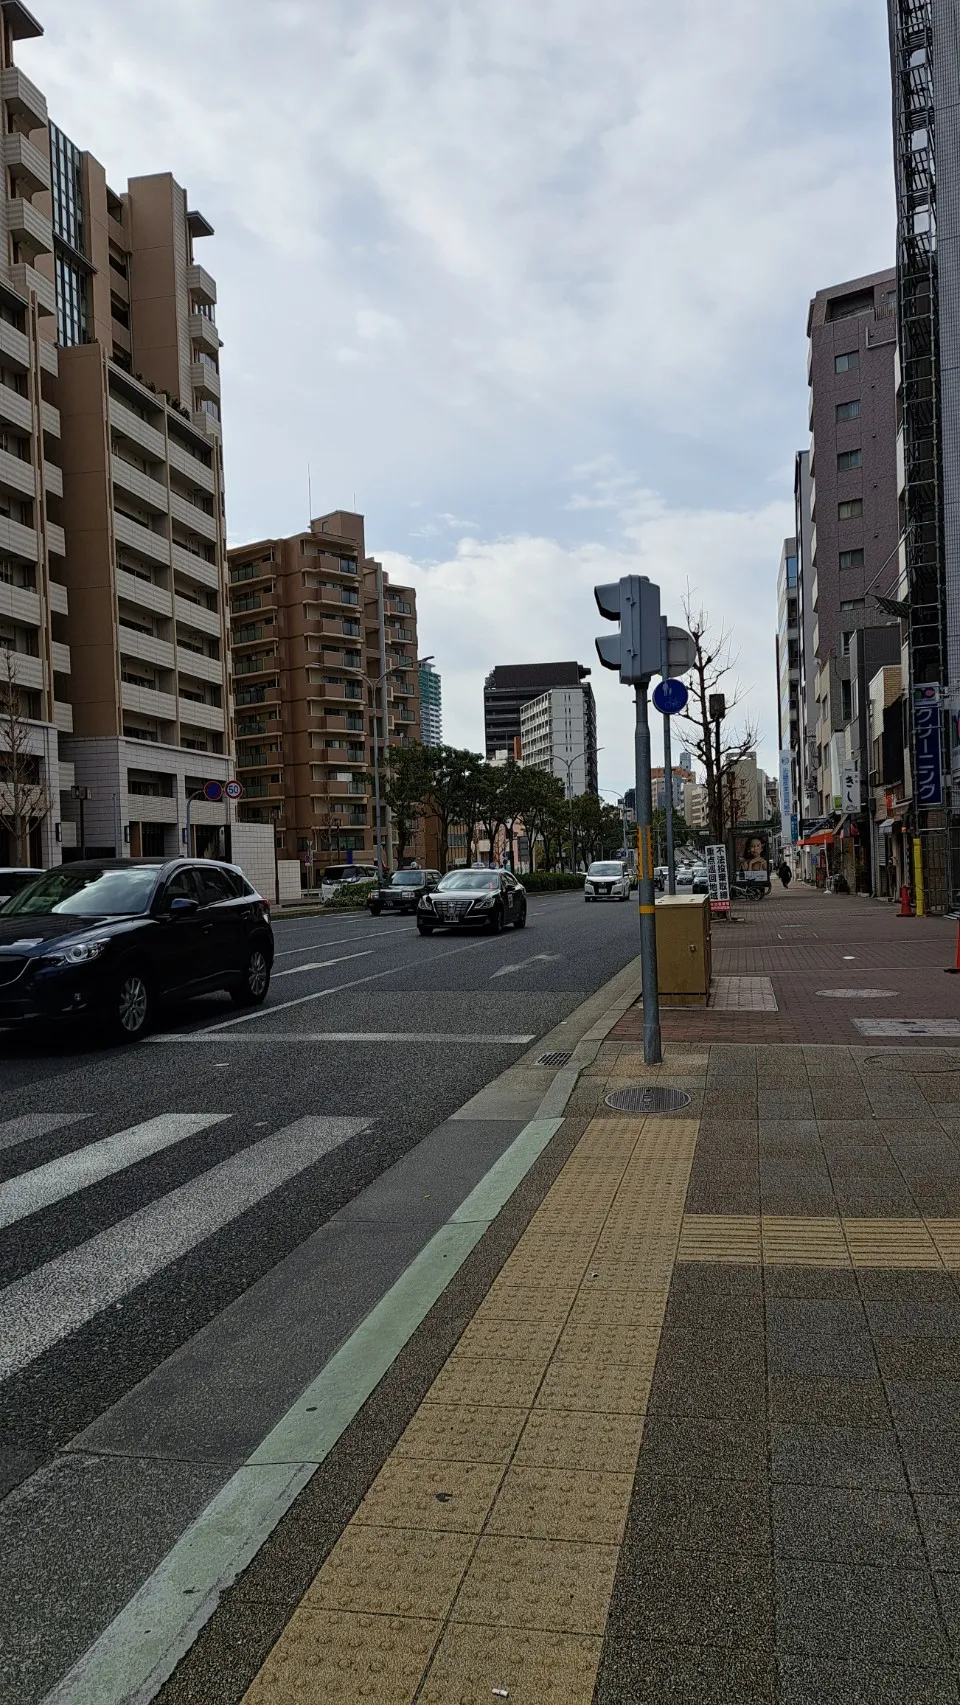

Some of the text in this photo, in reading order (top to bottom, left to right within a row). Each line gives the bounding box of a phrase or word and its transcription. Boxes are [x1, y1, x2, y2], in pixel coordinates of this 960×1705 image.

[916, 708, 936, 800] クリーニング
[228, 785, 239, 795] 50
[715, 846, 729, 900] 不法投棄取締
